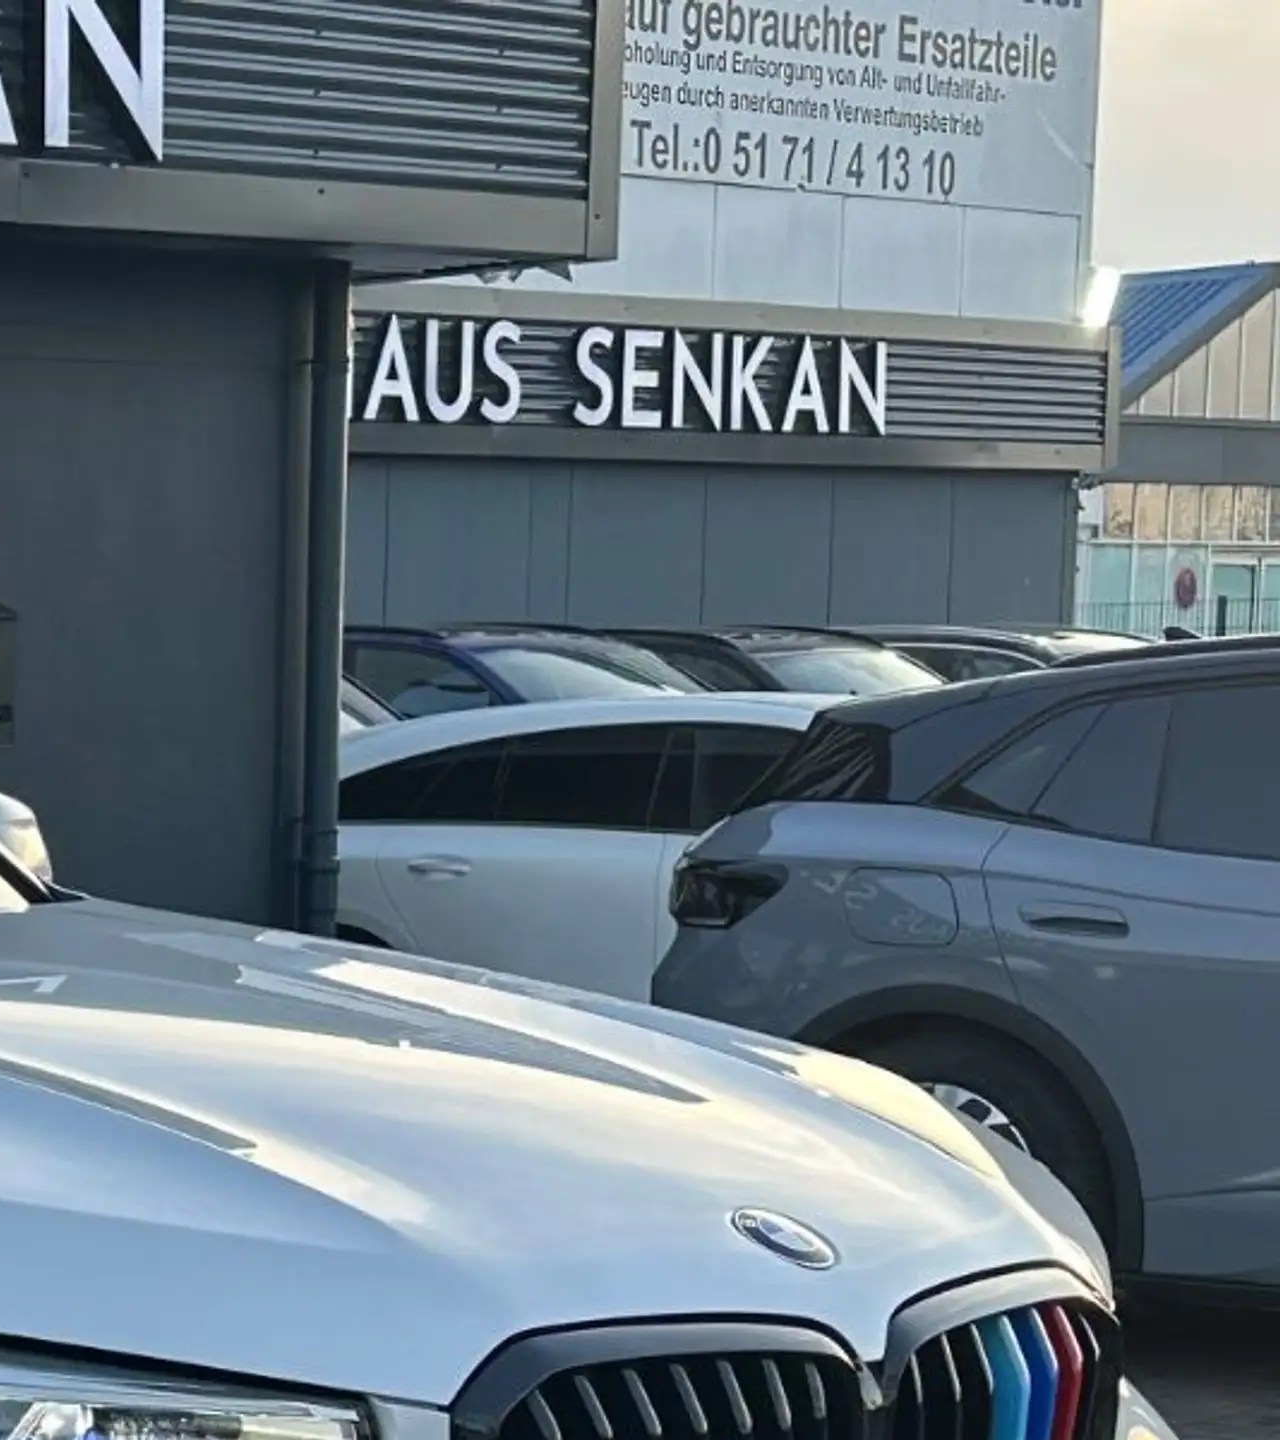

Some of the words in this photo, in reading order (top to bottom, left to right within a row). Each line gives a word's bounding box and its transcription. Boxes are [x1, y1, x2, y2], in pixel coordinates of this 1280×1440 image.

[683, 0, 886, 59] gebrauchter
[898, 14, 1057, 81] Ersatzteile
[697, 51, 727, 72] und
[733, 51, 823, 88] Entsorgung
[828, 66, 856, 86] von
[894, 72, 922, 94] und
[678, 82, 724, 108] durch
[730, 91, 829, 118] anerkannten
[834, 99, 984, 136] Verwertungsbetrieb
[733, 131, 767, 179] 51
[782, 135, 814, 183] 71
[846, 141, 864, 188] 4
[877, 144, 909, 192] 13
[923, 149, 955, 196] 10
[574, 326, 886, 435] SENKAN
